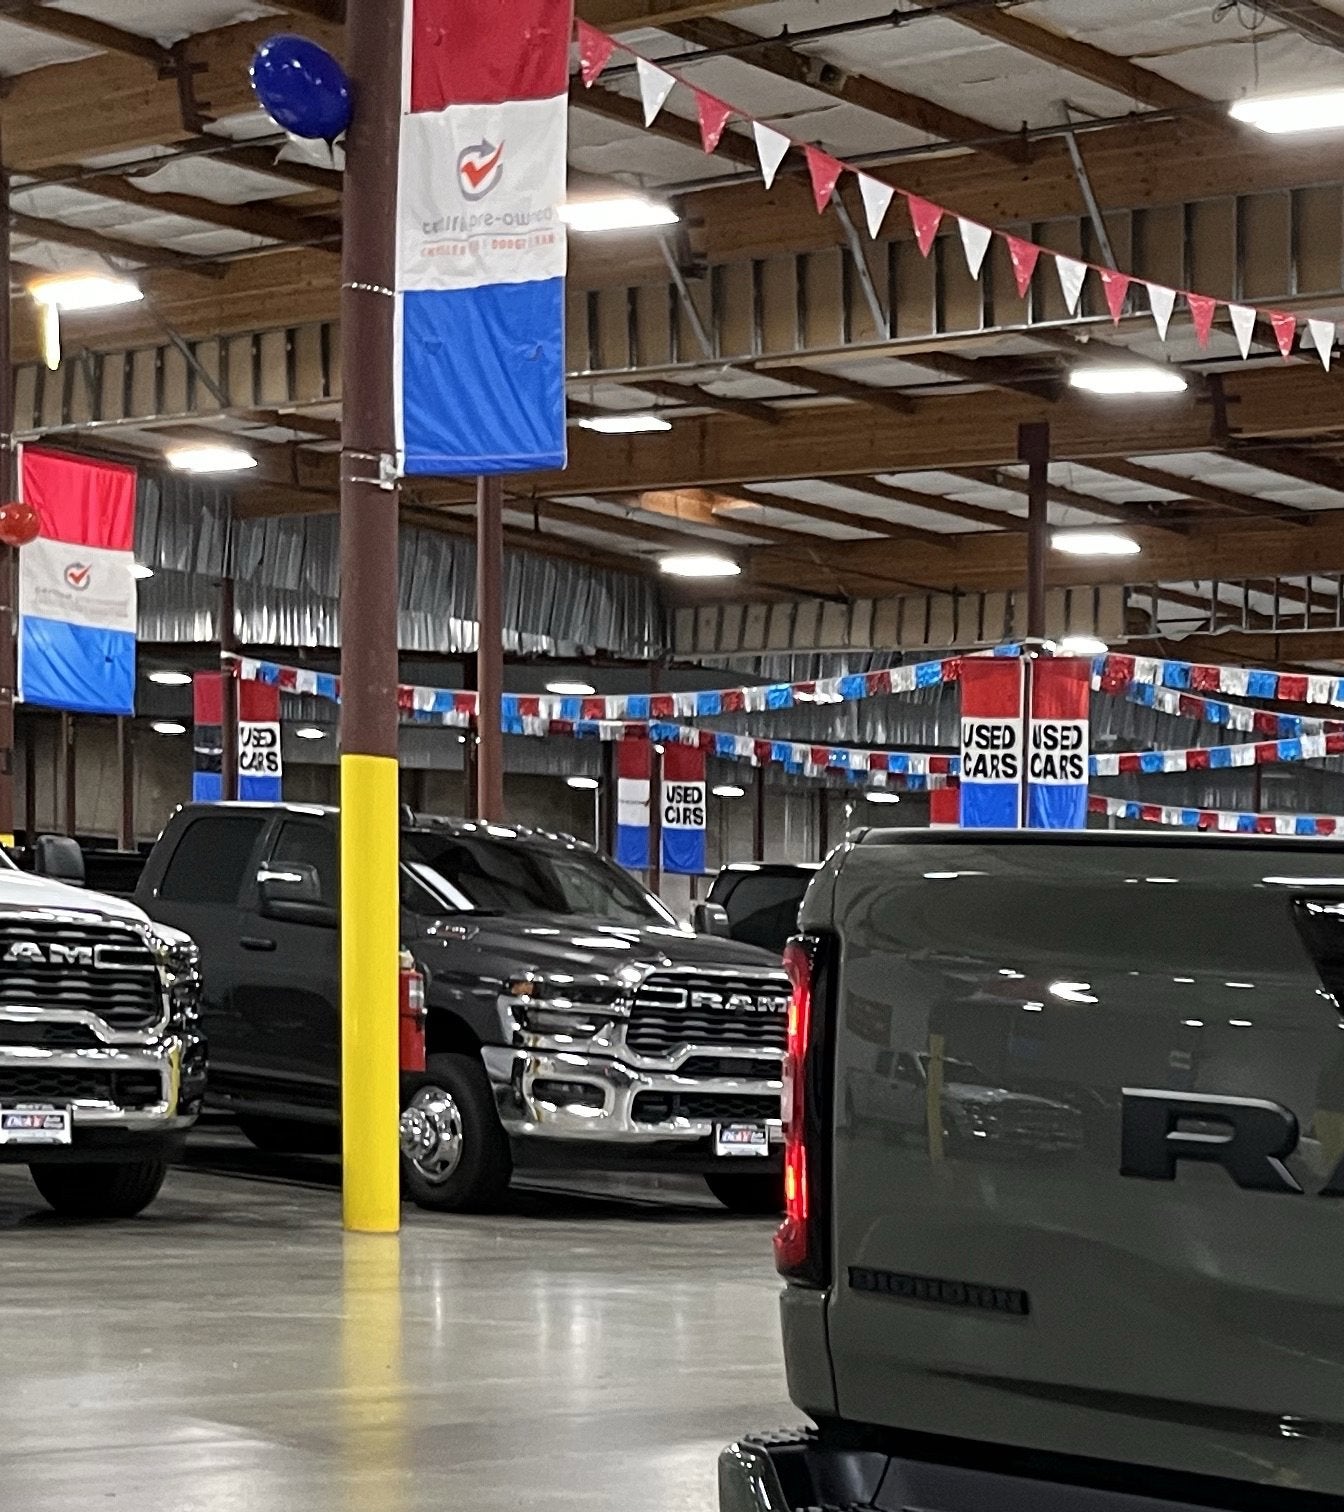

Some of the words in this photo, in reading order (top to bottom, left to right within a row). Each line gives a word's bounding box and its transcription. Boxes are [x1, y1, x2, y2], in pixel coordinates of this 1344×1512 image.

[963, 723, 1016, 750] USED
[1032, 724, 1083, 751] USED
[963, 752, 1018, 779] CARS
[1030, 753, 1084, 780] CARS
[666, 785, 703, 805] USED
[3, 942, 93, 965] AM
[692, 991, 787, 1013] RAM
